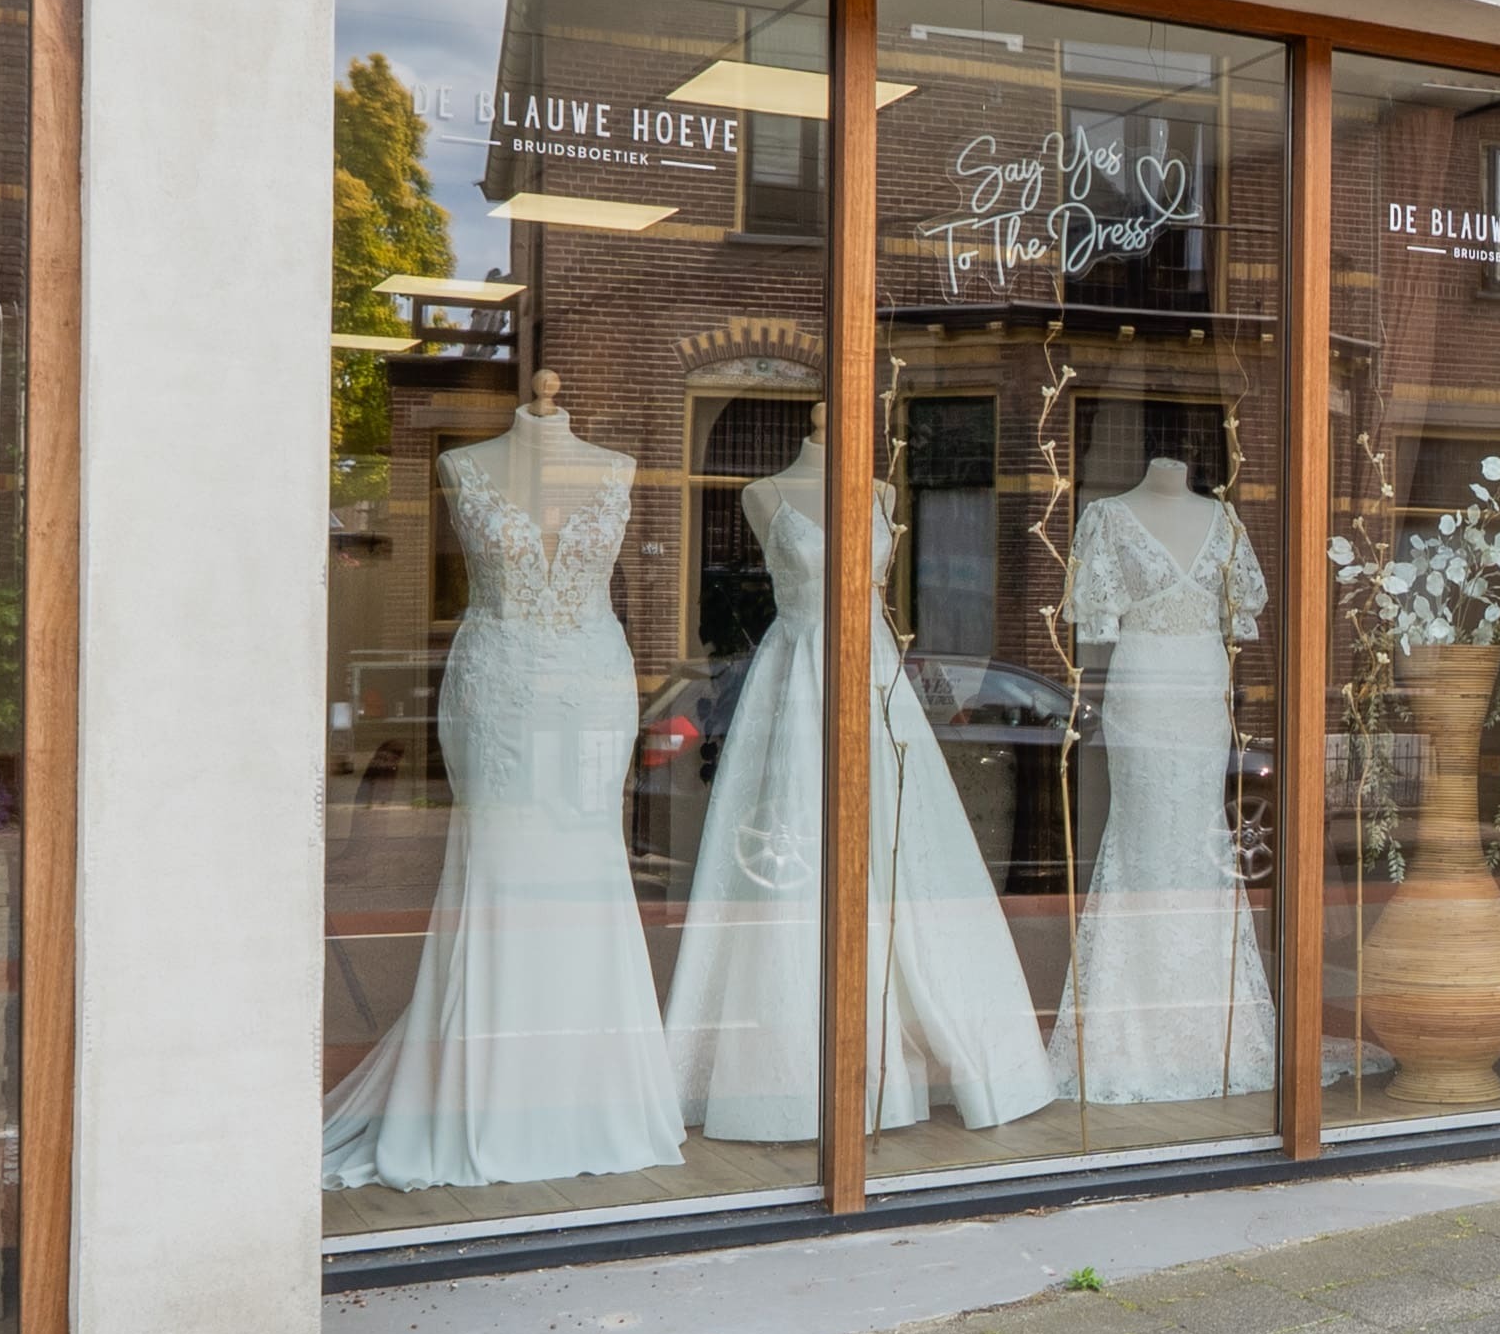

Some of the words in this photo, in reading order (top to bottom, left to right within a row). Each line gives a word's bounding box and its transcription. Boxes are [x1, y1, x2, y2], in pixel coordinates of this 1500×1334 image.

[413, 82, 454, 118] DE
[477, 90, 611, 138] BLAUWE
[632, 108, 738, 153] HOEVE
[513, 138, 649, 166] BRUIDSBOETIEK
[956, 135, 1044, 213] Say
[1042, 125, 1123, 200] Yes
[924, 218, 979, 294] To
[972, 211, 1047, 286] The
[1047, 202, 1151, 273] Dress
[1389, 203, 1417, 234] DE
